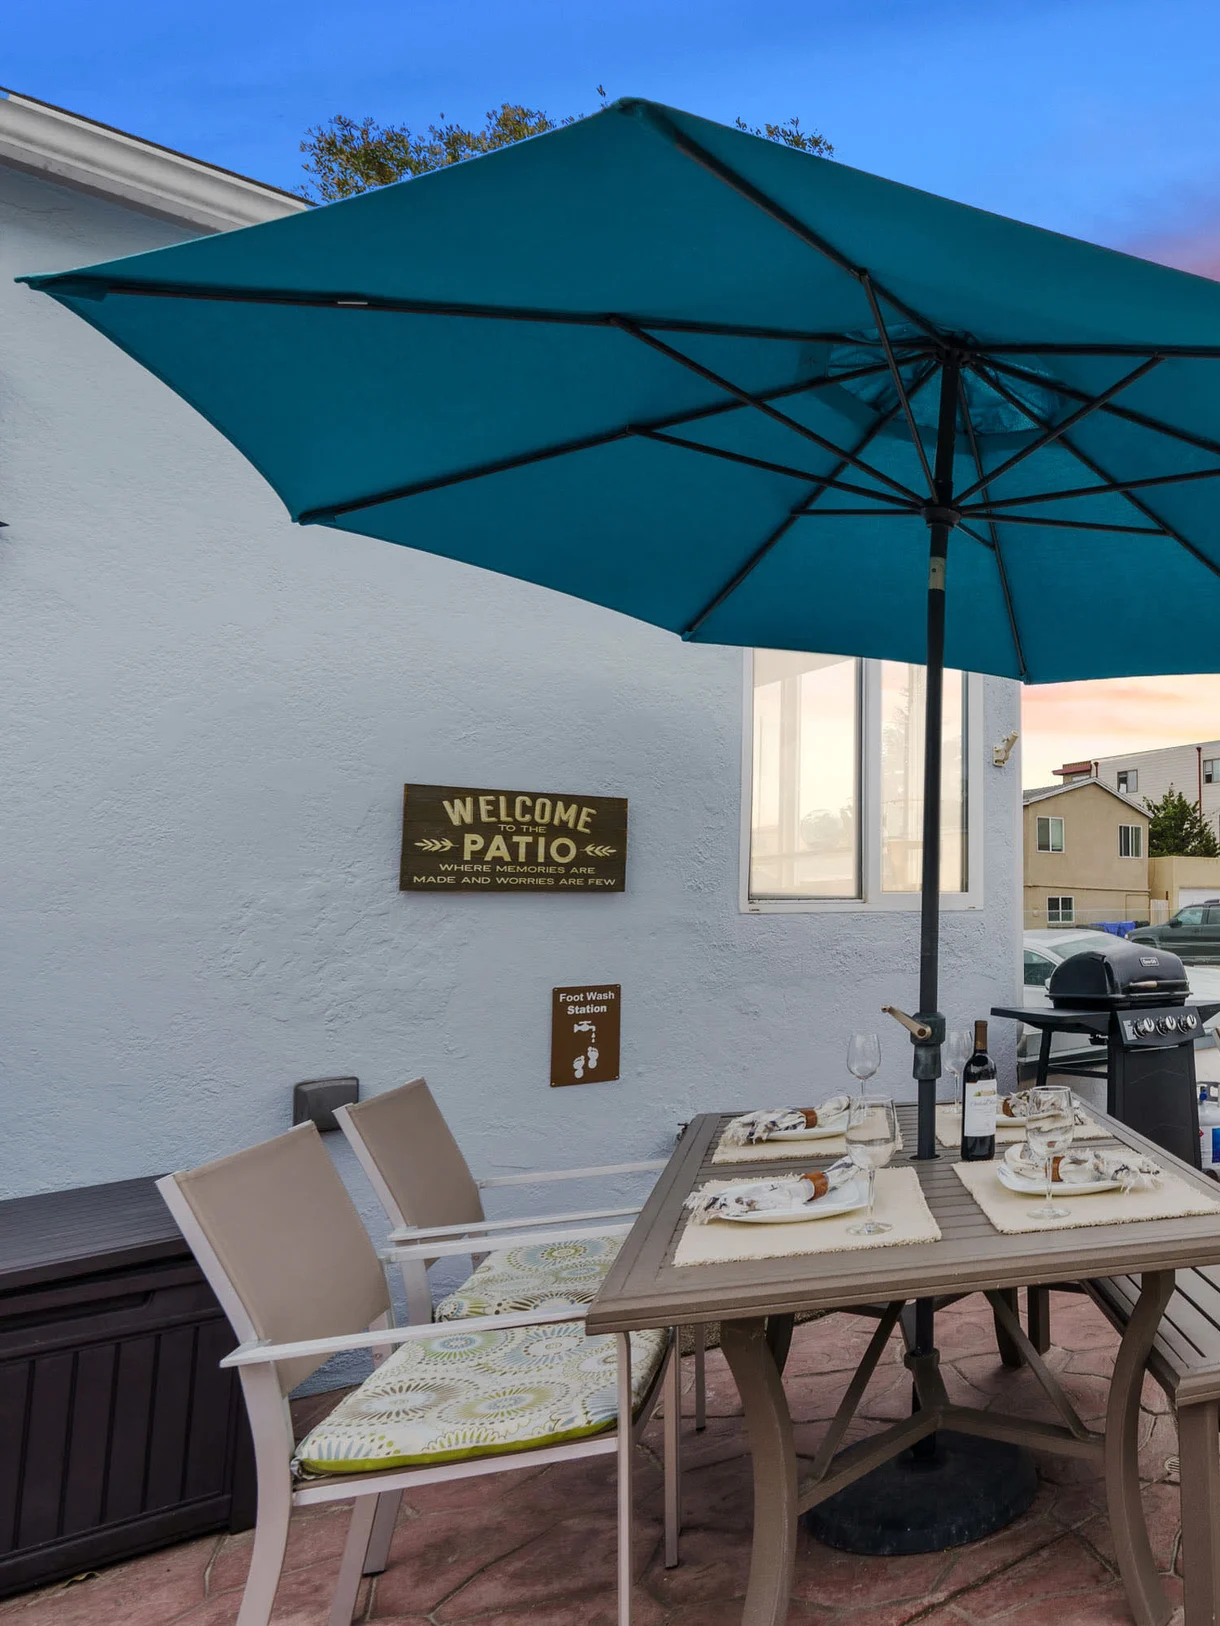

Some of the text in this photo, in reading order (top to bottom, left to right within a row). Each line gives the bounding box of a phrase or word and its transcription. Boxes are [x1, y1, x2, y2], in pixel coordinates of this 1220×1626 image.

[442, 795, 598, 834] WELCOME
[498, 824, 547, 834] TO THE
[463, 833, 577, 864] PATIO
[439, 863, 596, 875] WHERE MEMORIES ARE
[413, 875, 616, 886] MADE AND WORRIES ARE FEW
[559, 990, 615, 1002] Foot Wash
[567, 1004, 607, 1015] Station
